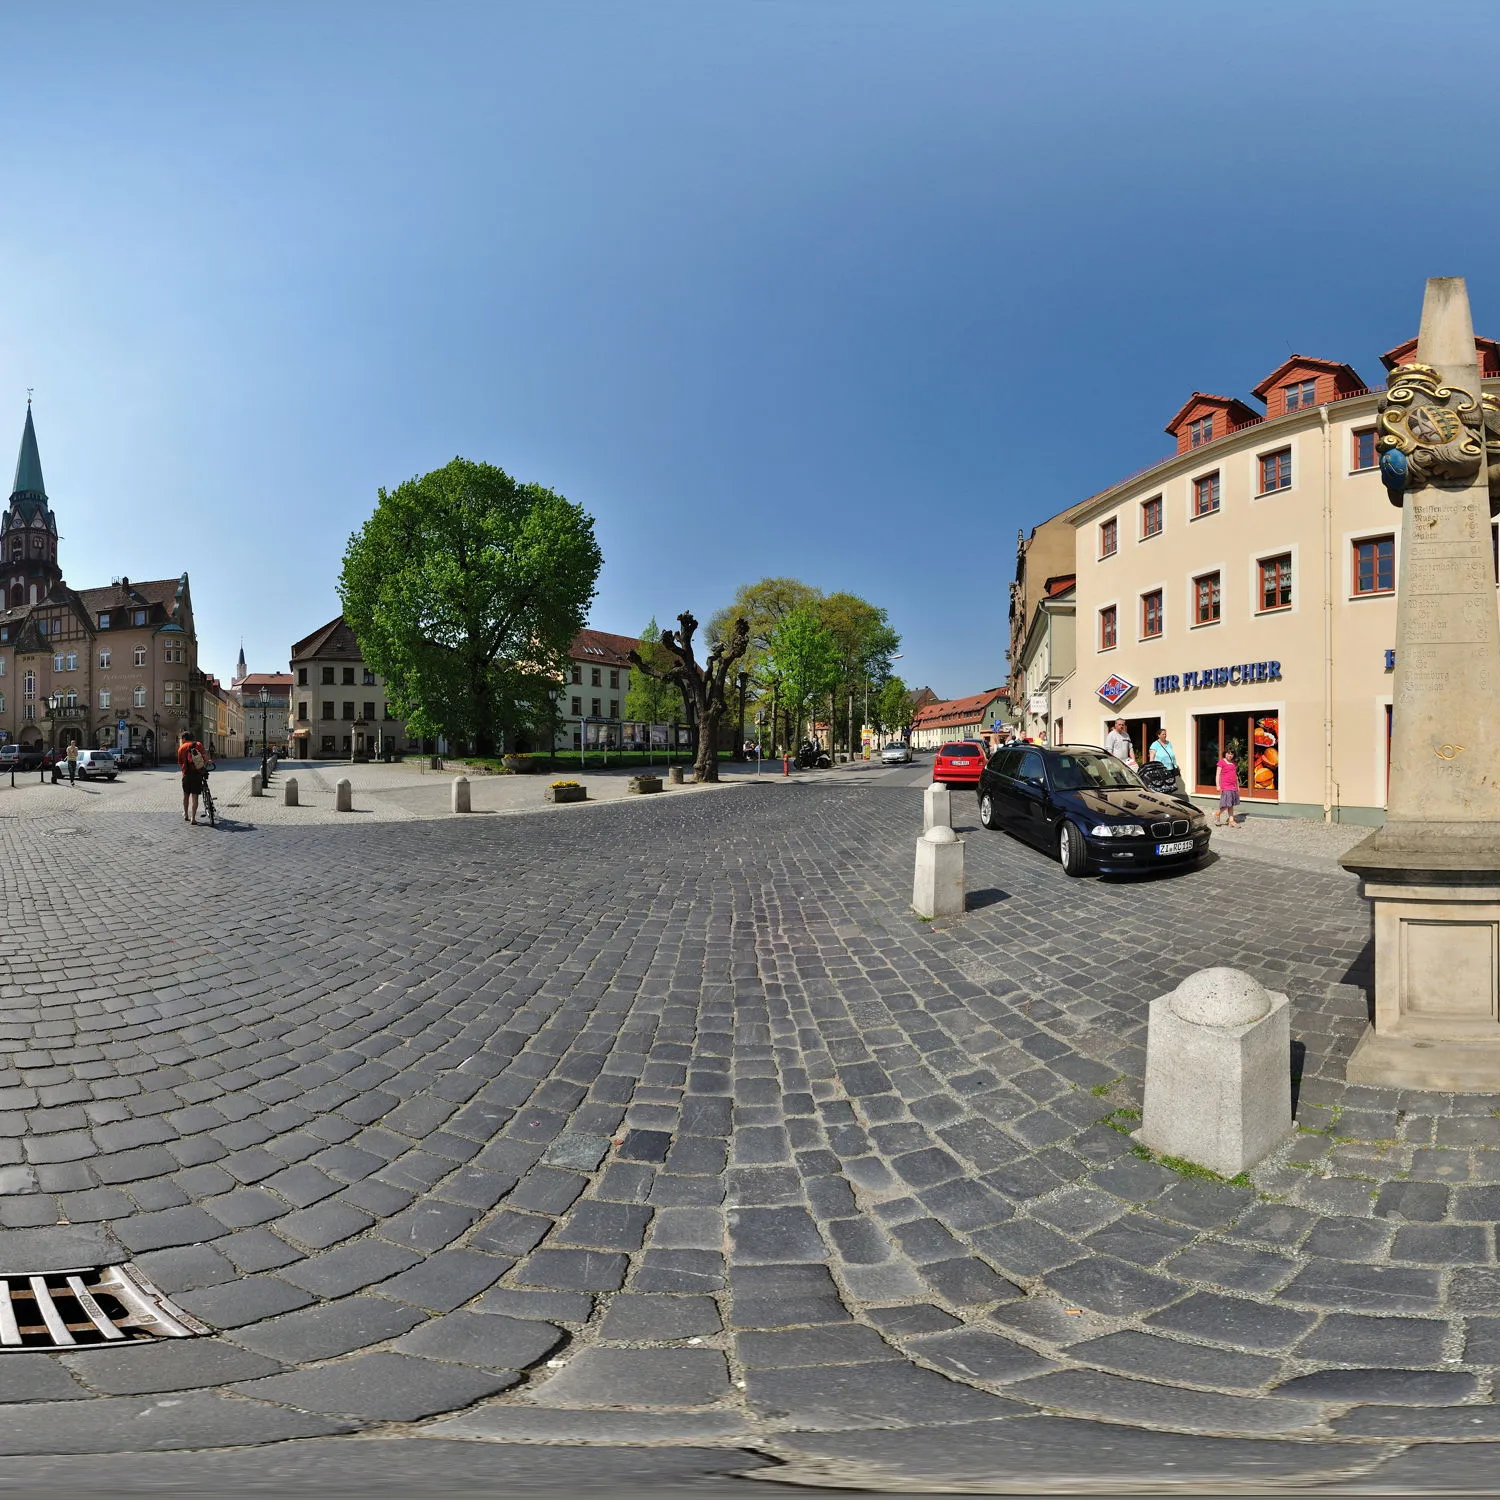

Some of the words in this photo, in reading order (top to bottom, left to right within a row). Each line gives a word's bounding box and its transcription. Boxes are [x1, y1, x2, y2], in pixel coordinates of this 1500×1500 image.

[1153, 674, 1179, 692] IHR
[1182, 660, 1281, 688] FLEISCHER
[119, 721, 125, 730] P
